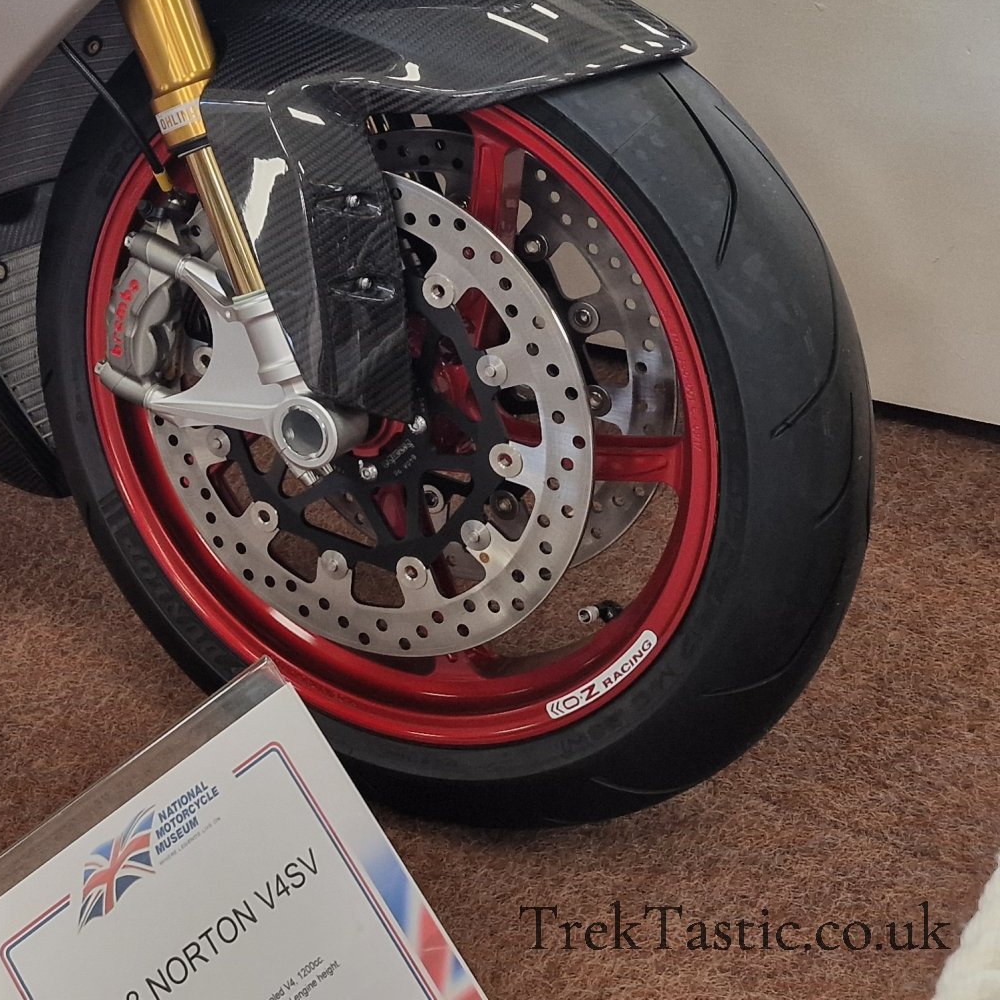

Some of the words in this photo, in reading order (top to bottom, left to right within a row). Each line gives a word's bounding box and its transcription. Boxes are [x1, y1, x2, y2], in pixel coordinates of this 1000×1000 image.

[110, 279, 140, 358] brembo
[602, 639, 652, 688] RACING
[155, 786, 219, 839] MOTORCYCLE
[158, 781, 208, 823] NATIONAL
[155, 816, 199, 855] MUSEUM
[145, 900, 258, 1000] NORTON
[253, 847, 319, 910] V4SV
